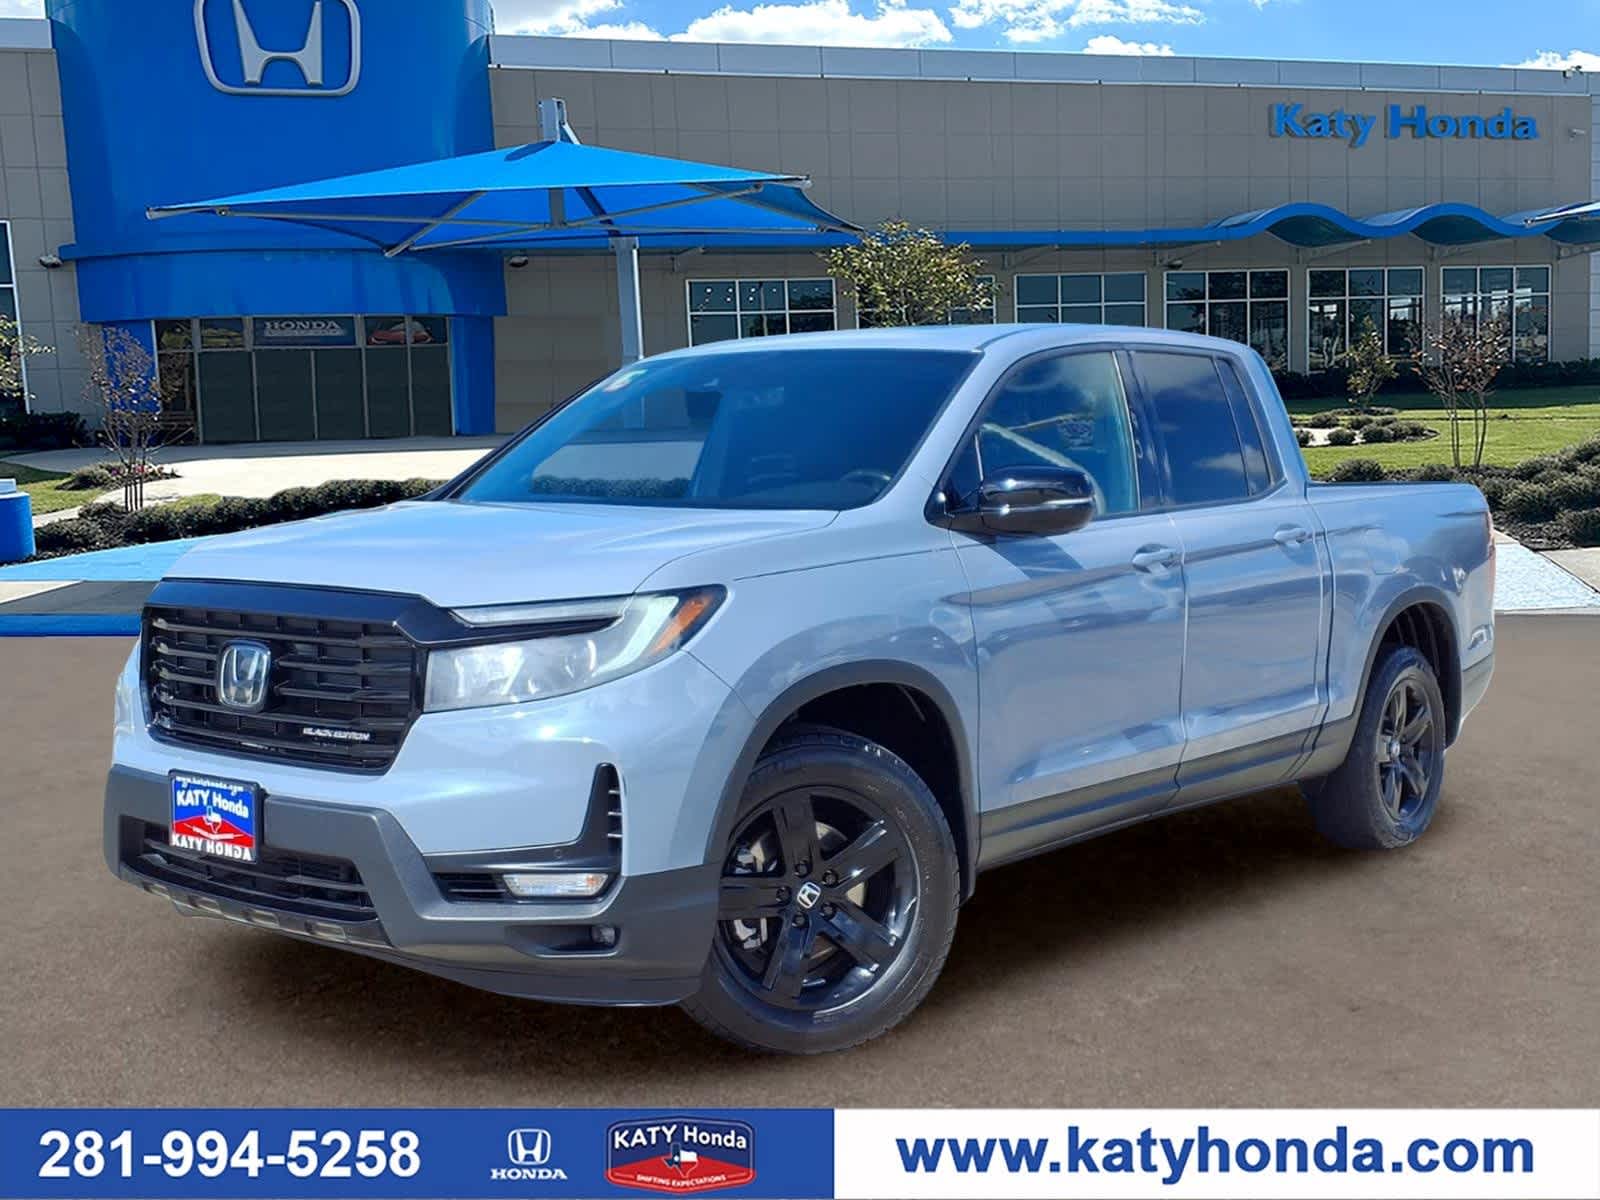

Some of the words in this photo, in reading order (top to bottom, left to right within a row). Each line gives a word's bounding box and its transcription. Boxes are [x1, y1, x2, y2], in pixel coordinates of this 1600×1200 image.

[1270, 103, 1376, 148] Katy
[1386, 104, 1538, 139] Honda
[264, 320, 341, 330] HONDA
[176, 789, 210, 807] KATY
[212, 791, 249, 818] Honda
[171, 833, 204, 851] KATY
[206, 840, 252, 861] HONDA
